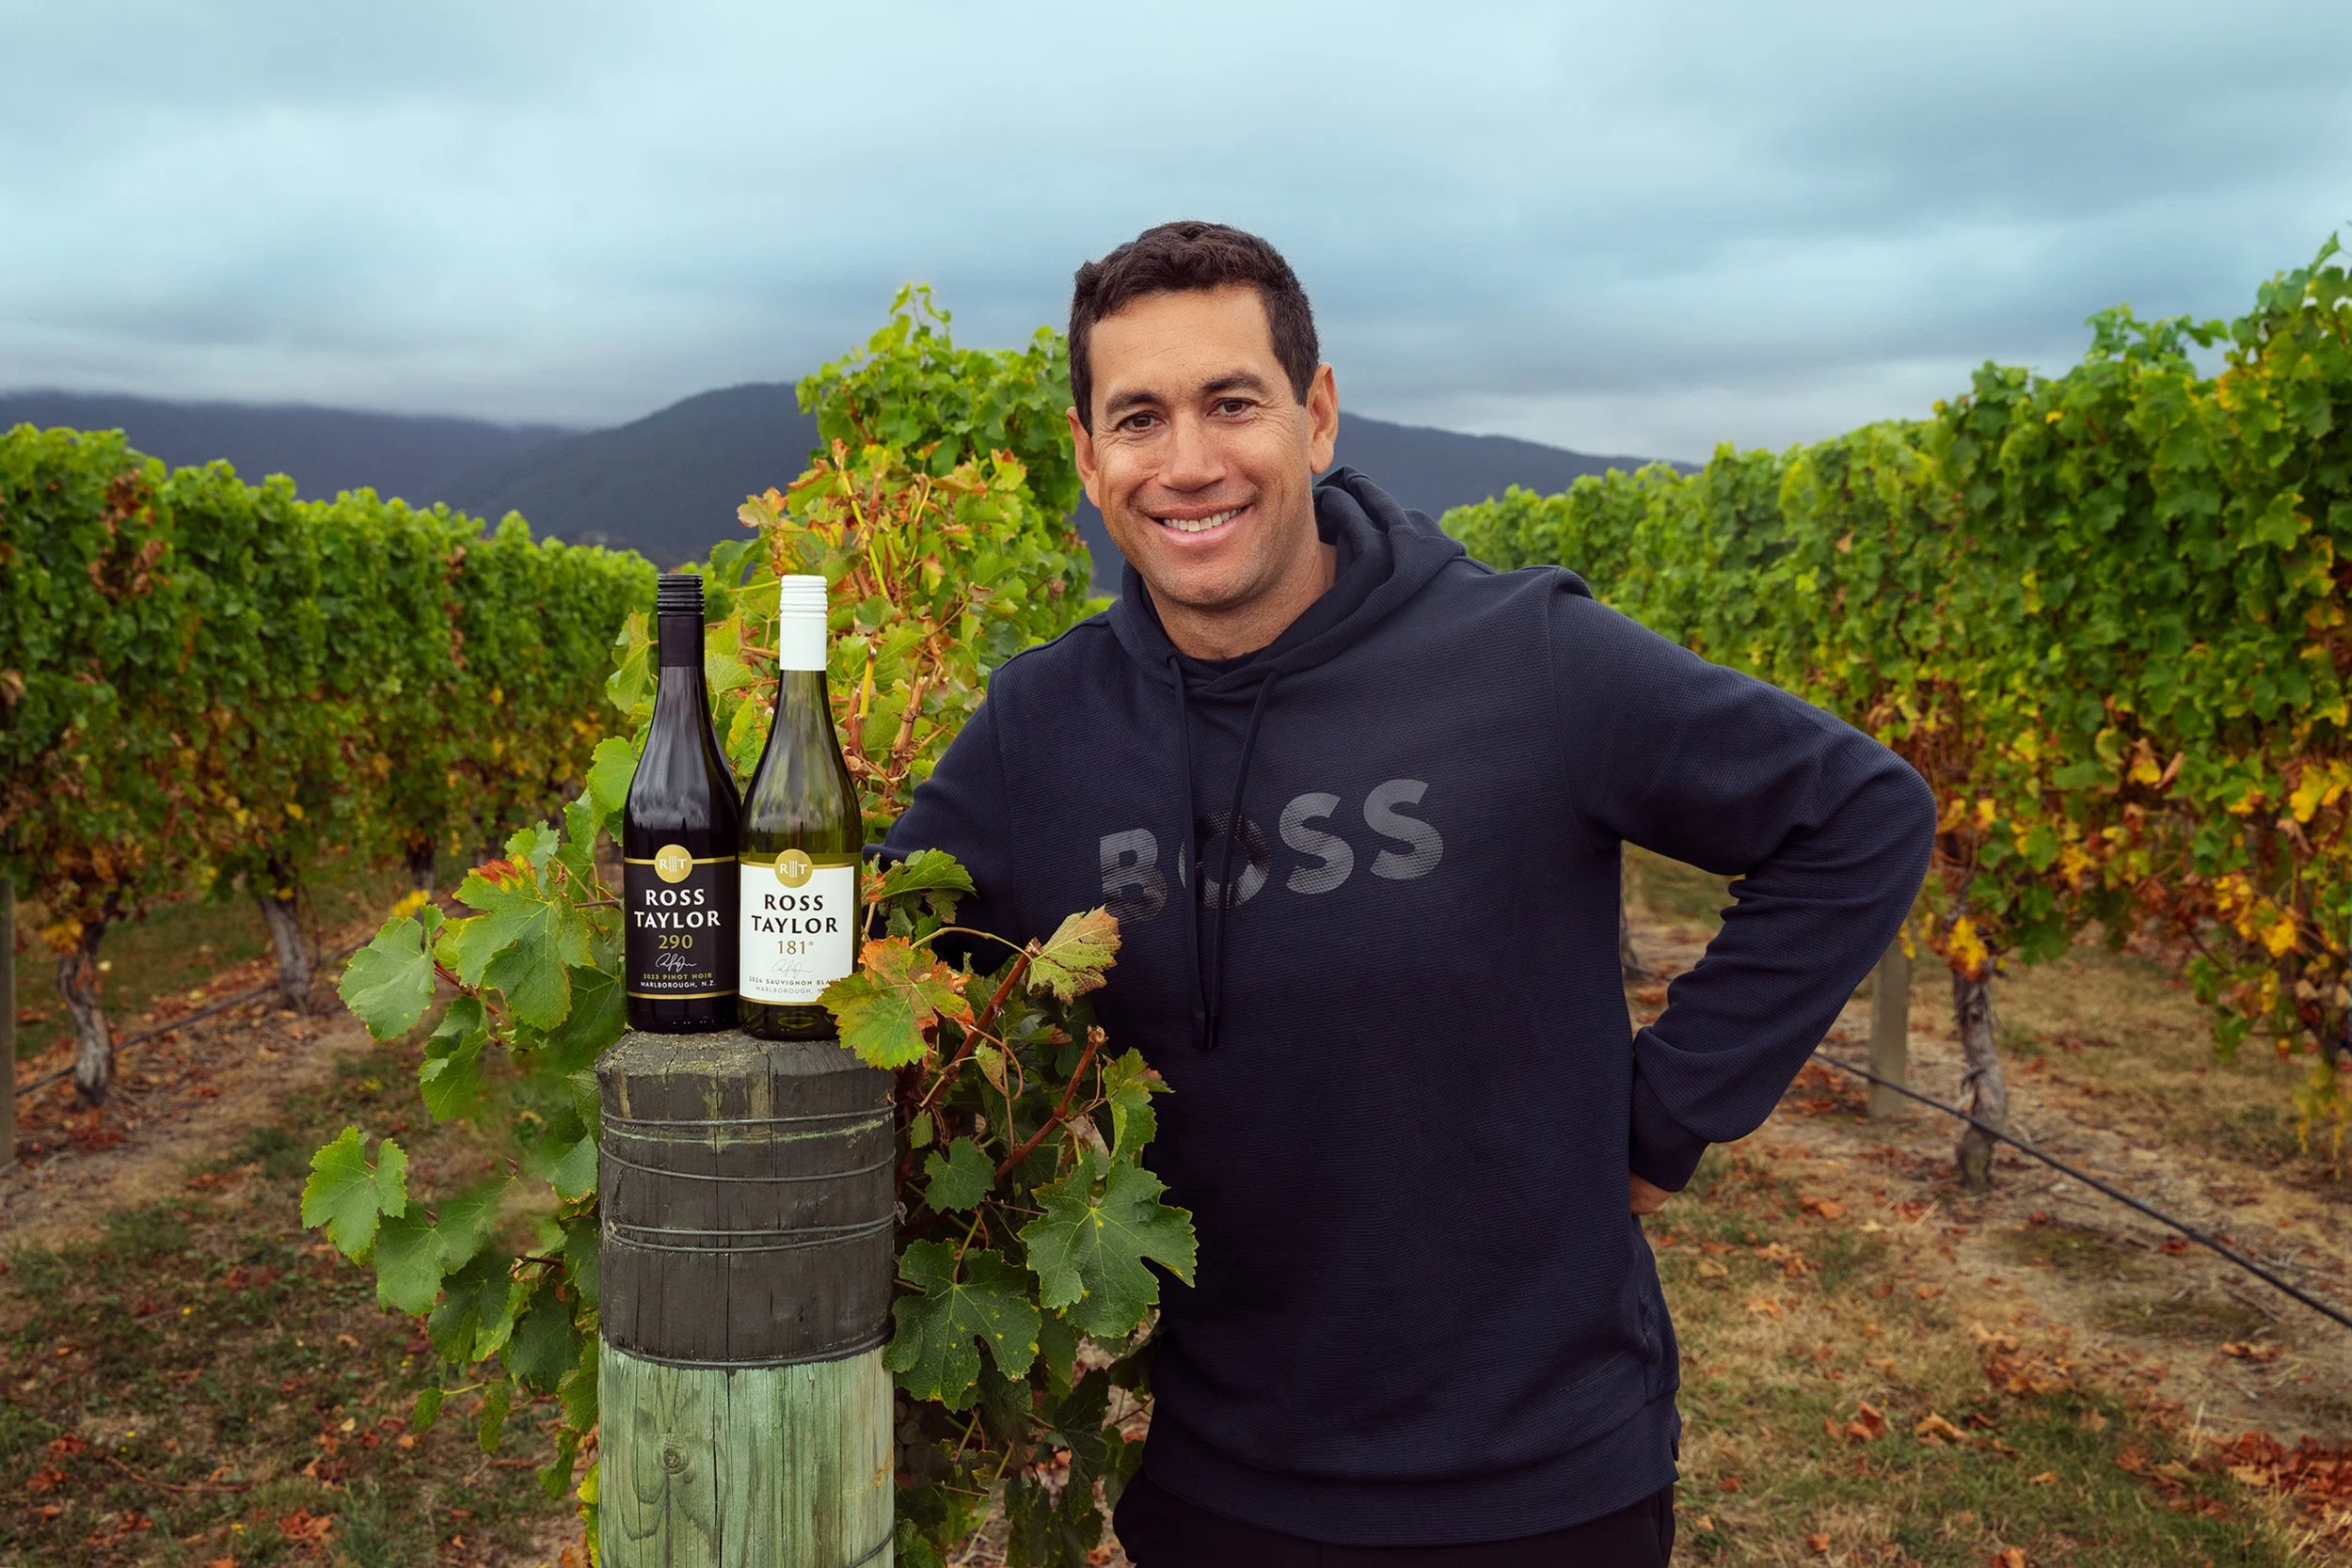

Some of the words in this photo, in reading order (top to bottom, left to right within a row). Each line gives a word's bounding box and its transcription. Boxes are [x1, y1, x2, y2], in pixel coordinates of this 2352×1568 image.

[1099, 778, 1443, 925] BOSS
[645, 888, 705, 907] ROSS
[764, 894, 824, 911] ROSS
[634, 911, 721, 929] TAYLOR
[752, 915, 838, 934] TAYLOR
[658, 934, 693, 949] 290
[640, 980, 698, 989] MARLBOROUGH,
